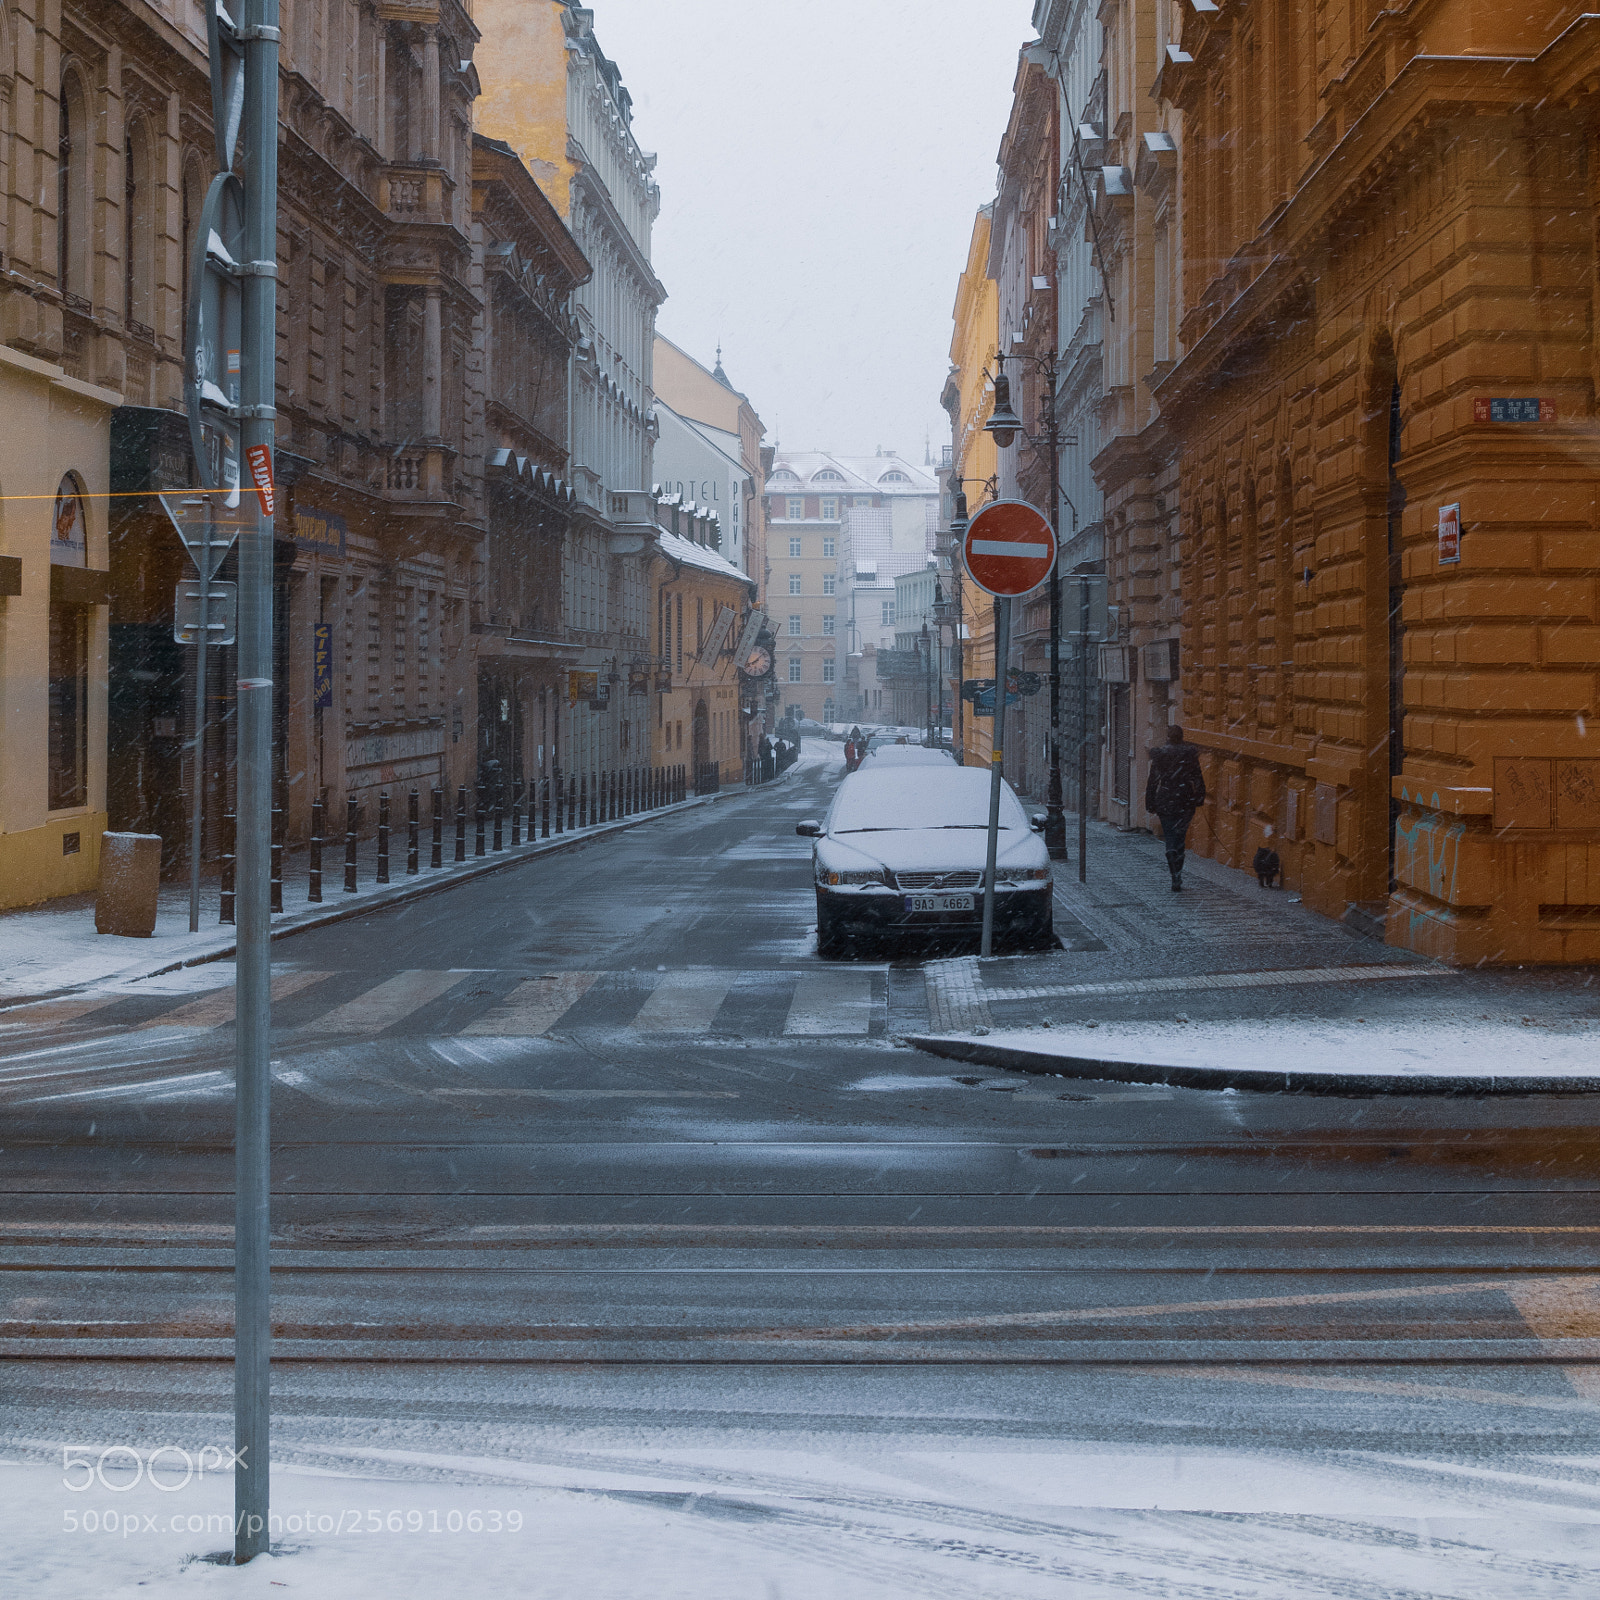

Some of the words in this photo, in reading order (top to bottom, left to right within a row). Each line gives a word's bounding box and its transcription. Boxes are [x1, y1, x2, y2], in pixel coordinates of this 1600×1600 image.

[665, 480, 720, 501] HOTEL
[315, 626, 329, 677] GIFT
[313, 678, 332, 703] shop
[914, 899, 935, 910] 9A3
[943, 898, 970, 909] 4662
